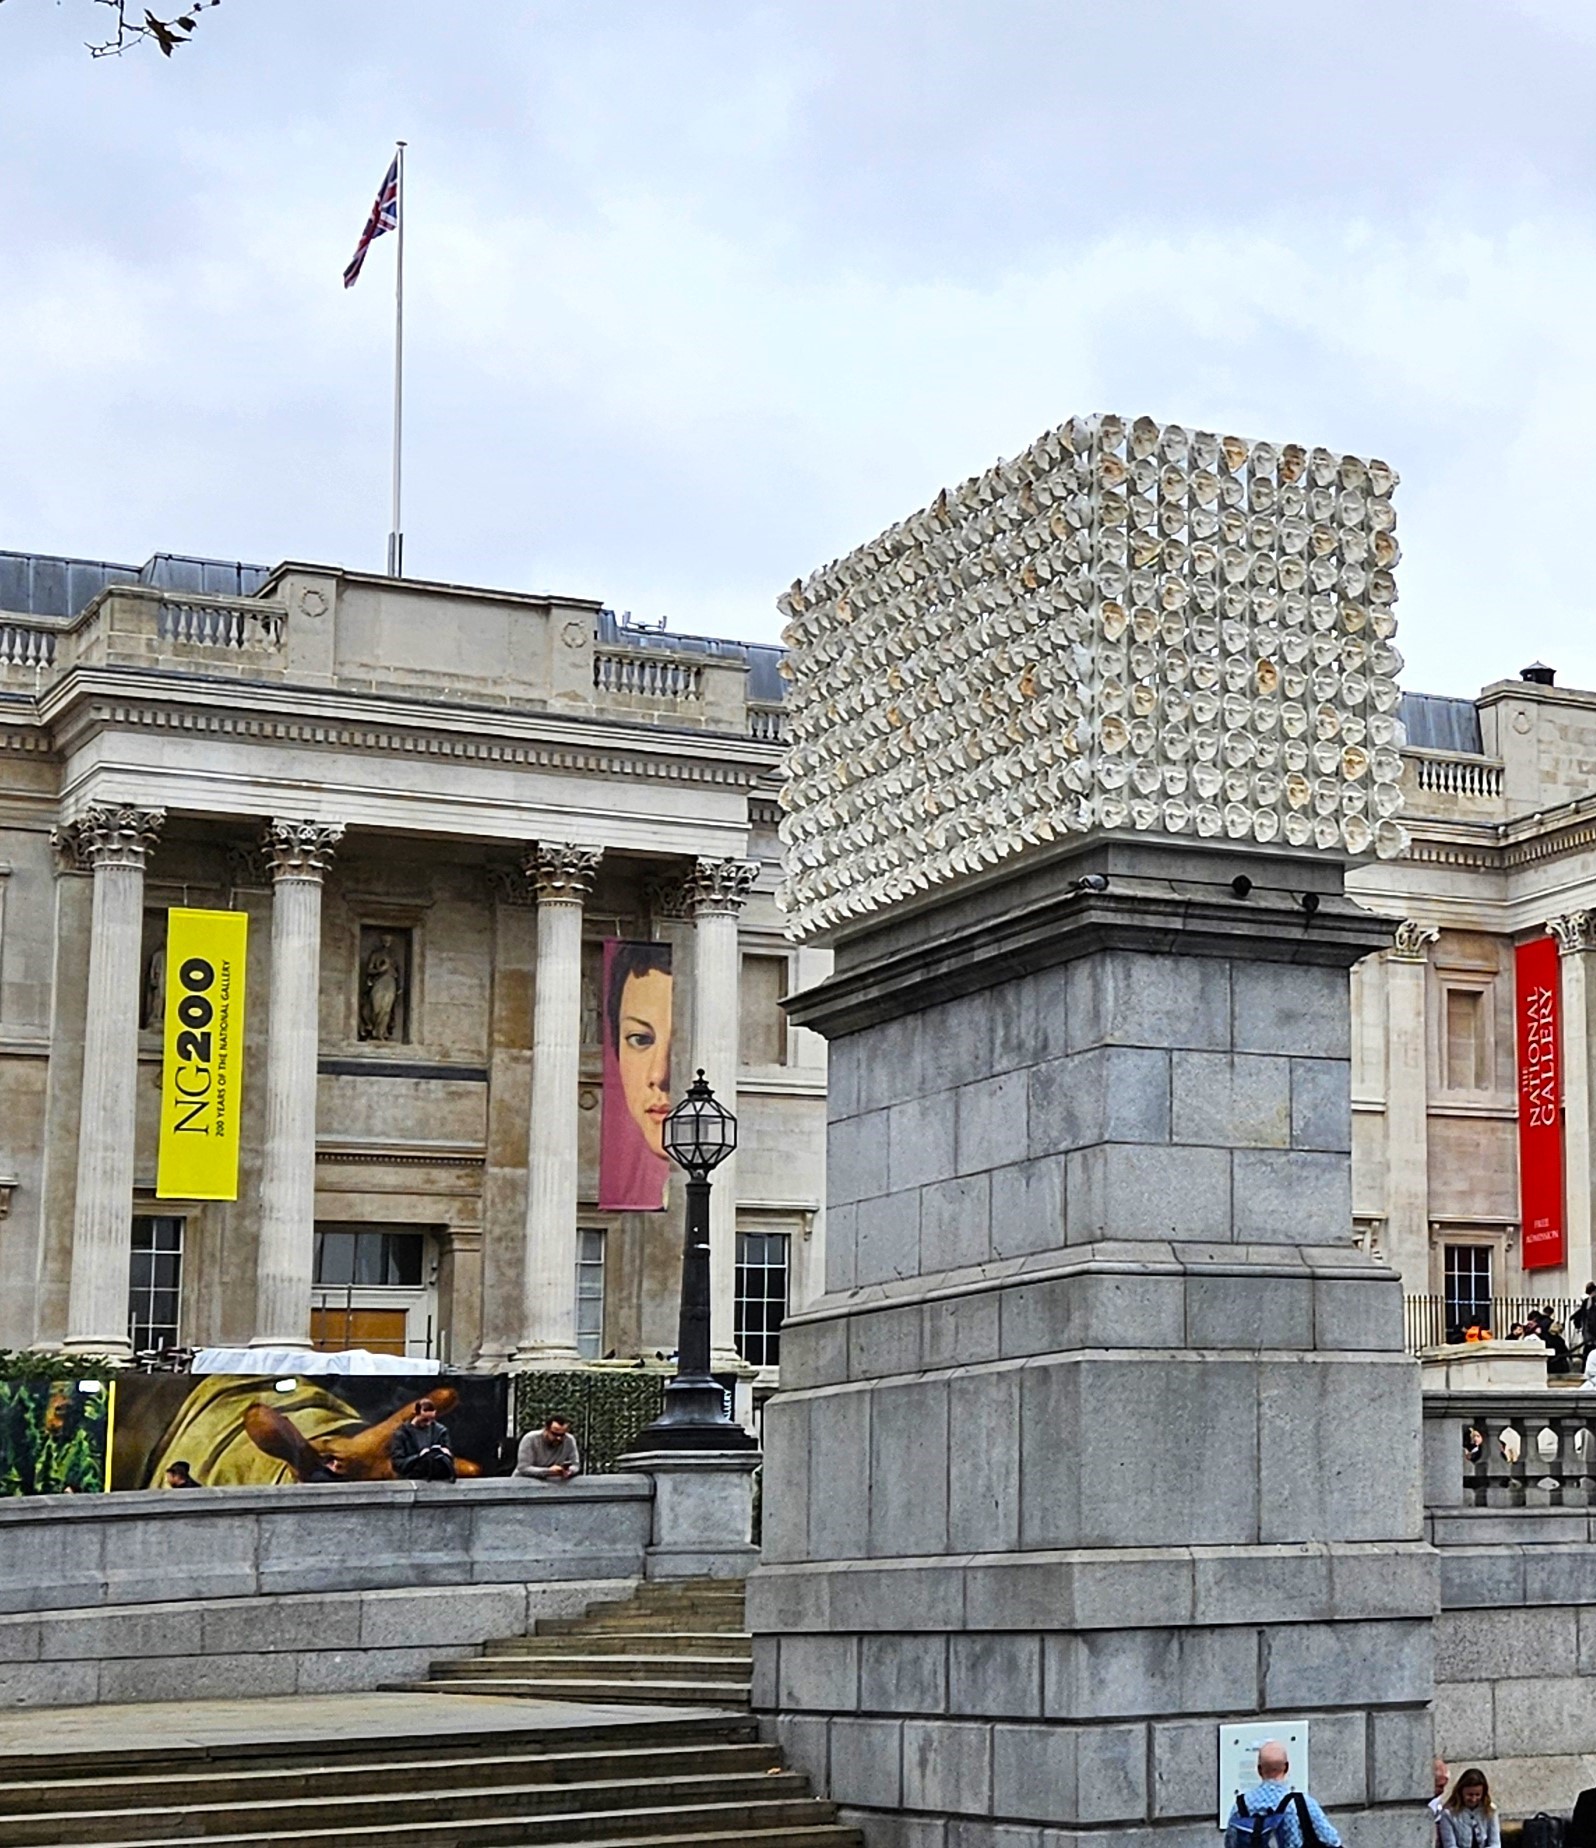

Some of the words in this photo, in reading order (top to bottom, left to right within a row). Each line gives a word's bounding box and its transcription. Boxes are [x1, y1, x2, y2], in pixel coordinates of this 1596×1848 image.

[221, 960, 231, 1001] GALLERY
[173, 957, 215, 1137] NG200
[219, 1003, 230, 1051] NATIONAL
[218, 1053, 228, 1070] THE
[1527, 986, 1541, 1127] NATIONAL
[1539, 986, 1555, 1126] GALLERY
[218, 1073, 227, 1086] OF
[217, 1088, 227, 1119] YEARS
[215, 1120, 225, 1137] 200
